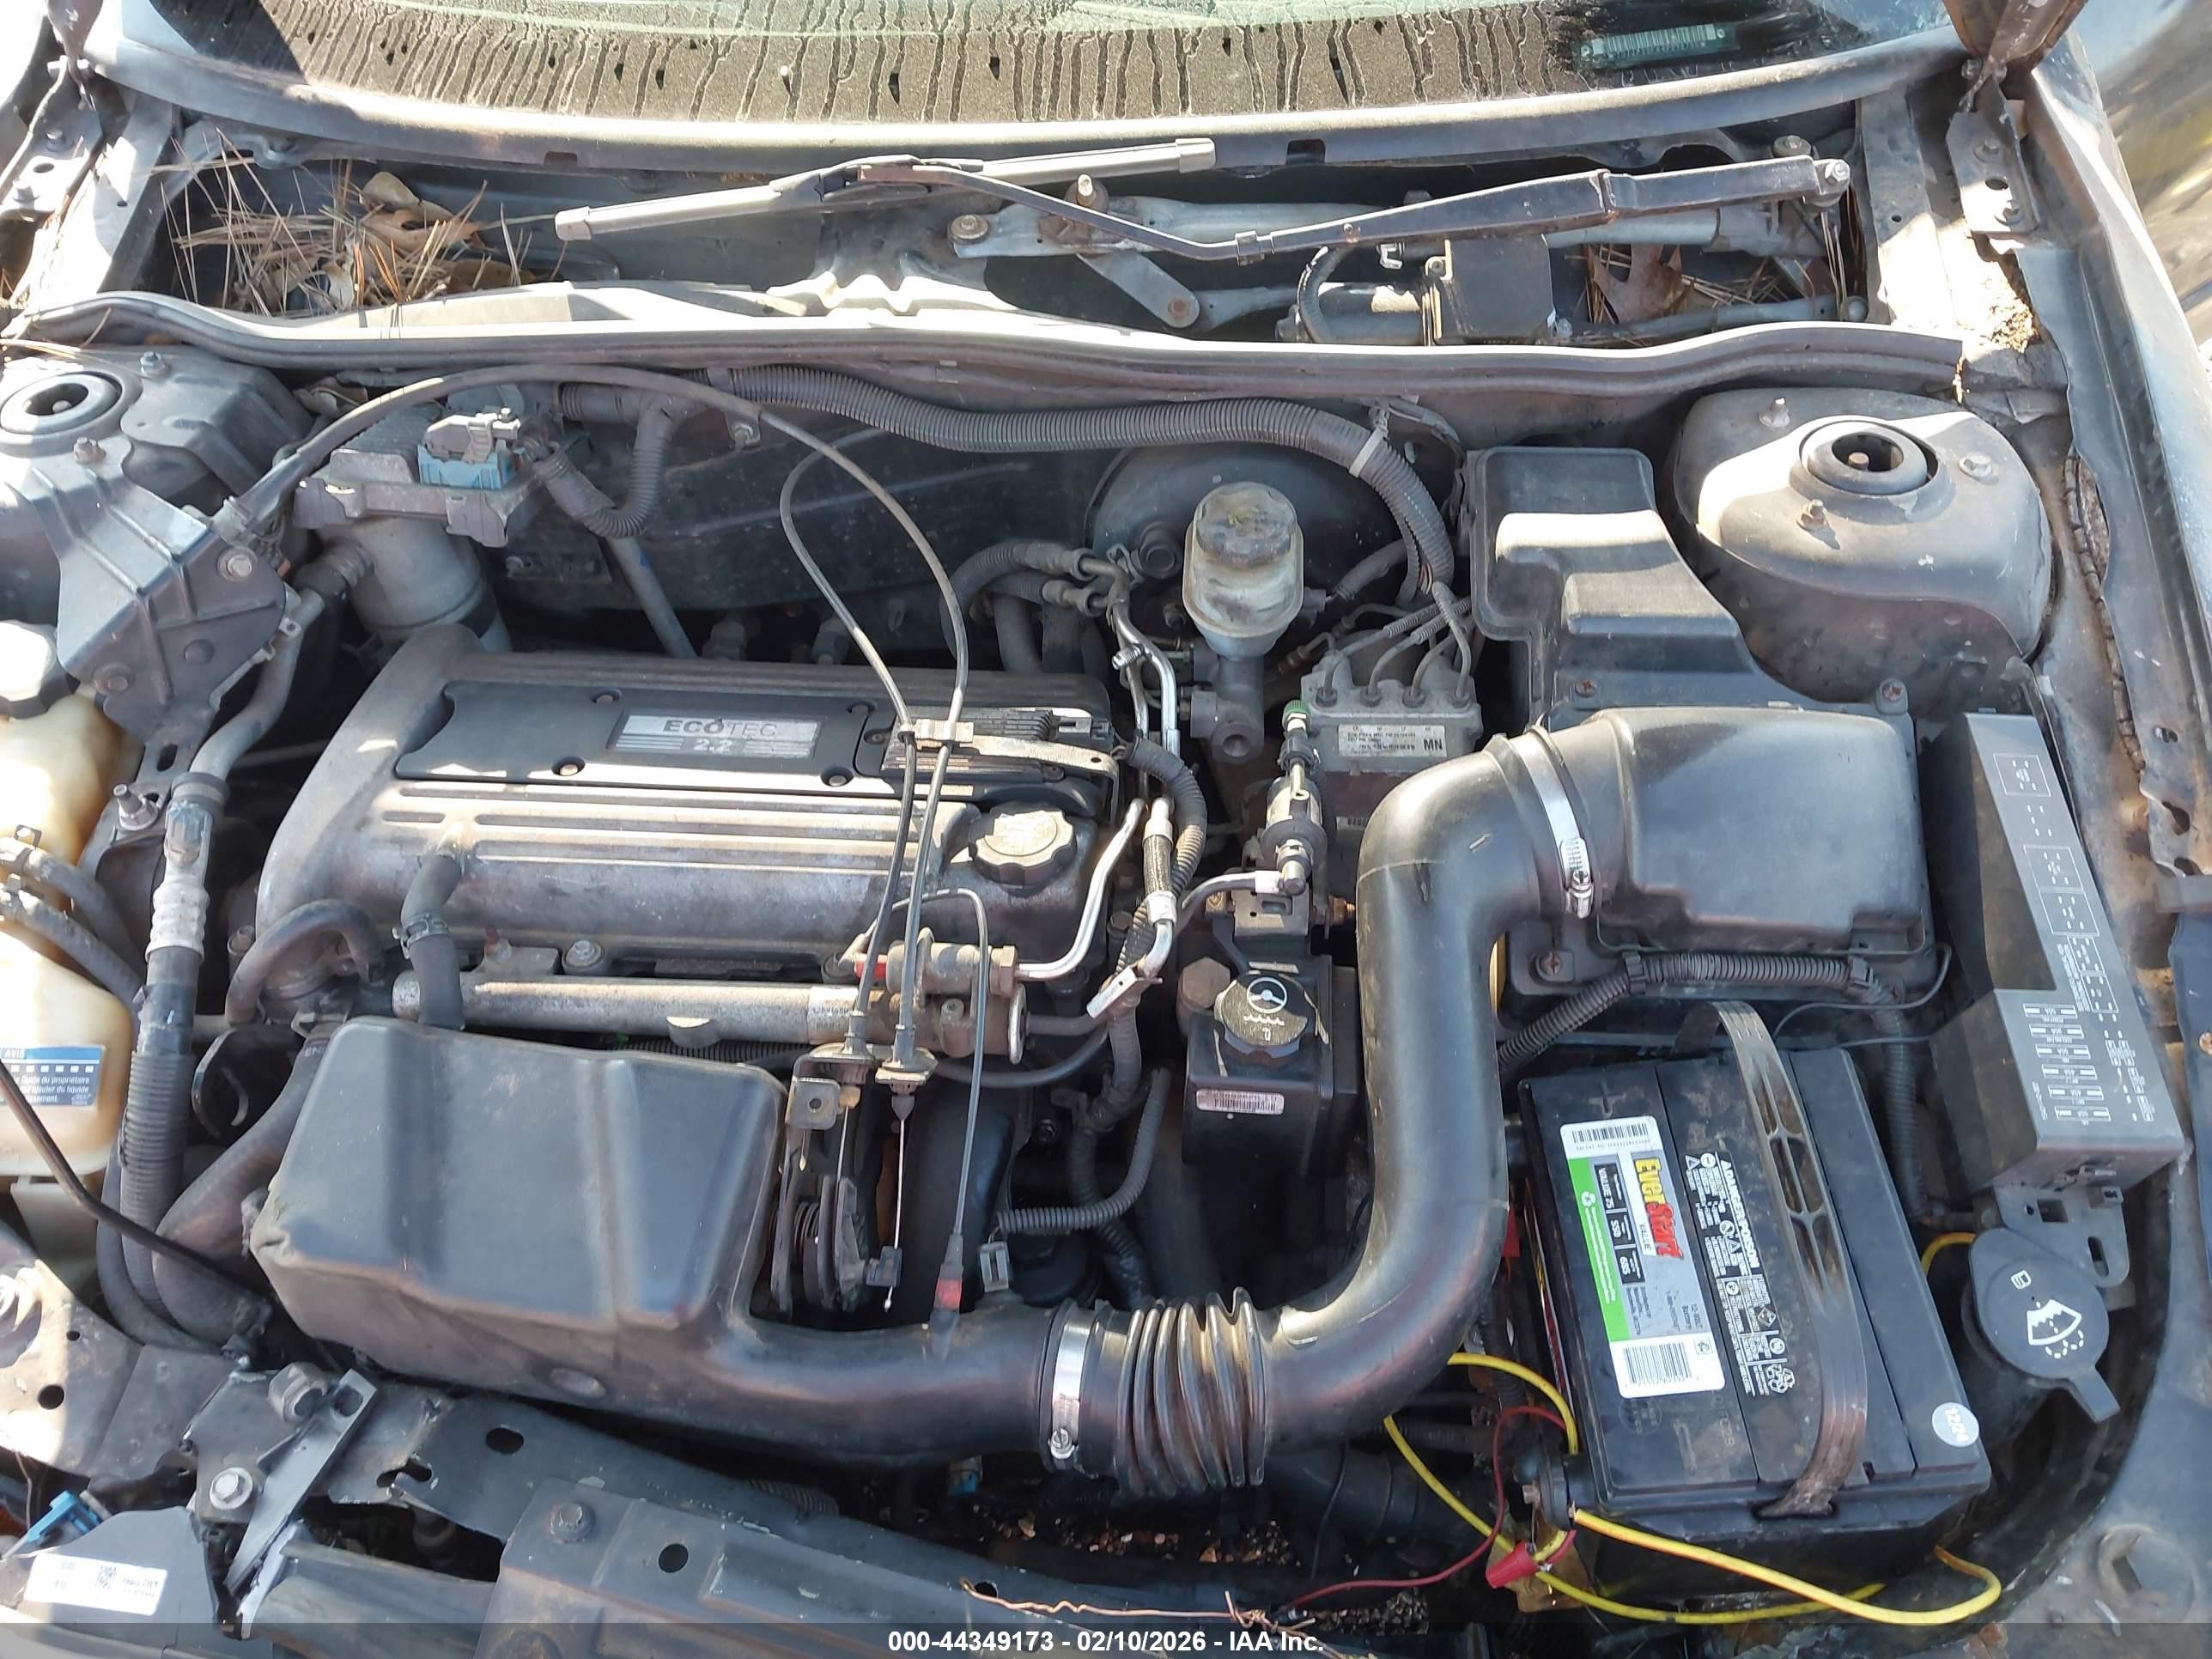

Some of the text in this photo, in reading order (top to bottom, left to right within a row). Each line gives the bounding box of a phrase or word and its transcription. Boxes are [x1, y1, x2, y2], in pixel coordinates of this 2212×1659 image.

[662, 720, 778, 738] ECOTEC
[693, 738, 732, 753] 2.2
[1424, 738, 1443, 750] MN
[41, 1075, 50, 1084] du
[66, 1085, 90, 1095] liquide
[1598, 1167, 1612, 1197] VALUE
[1635, 1157, 1684, 1260] EverStart
